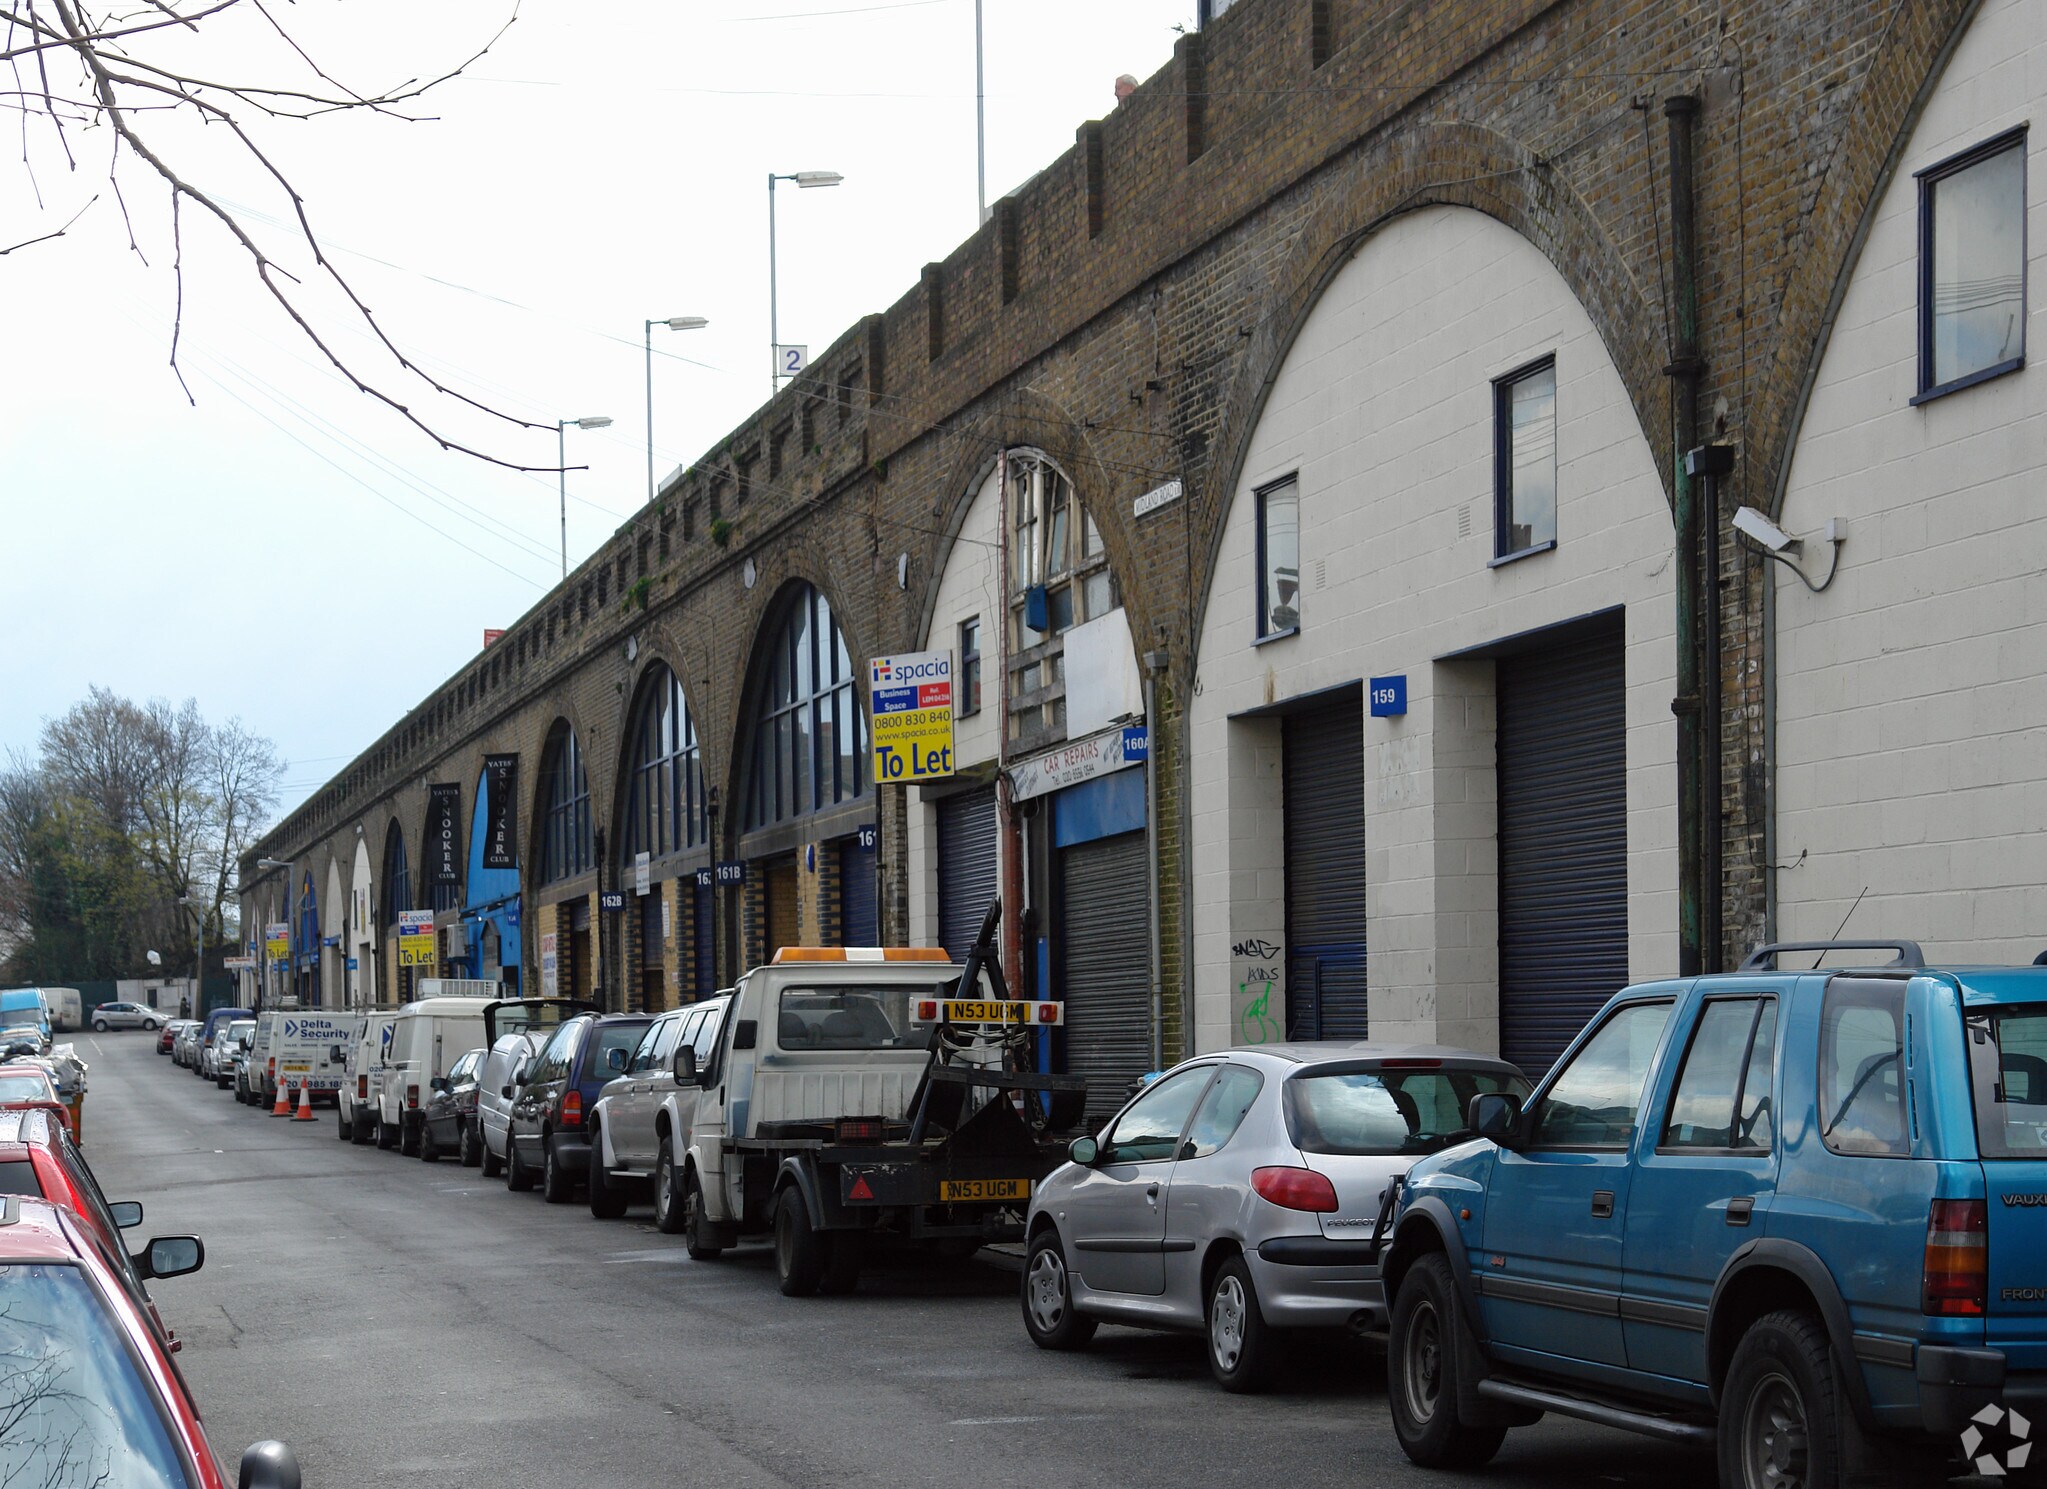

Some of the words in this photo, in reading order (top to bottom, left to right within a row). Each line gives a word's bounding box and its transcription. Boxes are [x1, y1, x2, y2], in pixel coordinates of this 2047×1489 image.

[786, 350, 801, 370] 2
[895, 658, 949, 685] spacia
[880, 689, 911, 699] Business
[1372, 689, 1395, 704] 159
[884, 702, 906, 711] Space
[874, 716, 902, 729] 0800
[905, 713, 926, 726] 830
[930, 711, 950, 723] 840
[875, 726, 950, 741] www.spacia.co.uk
[876, 746, 904, 778] To
[912, 743, 951, 775] Let
[1044, 757, 1059, 774] CAR
[1064, 741, 1098, 767] REPAIRS
[495, 768, 507, 854] SNOOKER
[442, 796, 452, 872] SNOOKER
[717, 866, 741, 879] 161B
[602, 895, 622, 907] 162B
[268, 948, 276, 958] To
[277, 948, 287, 957] Let
[401, 949, 413, 964] To
[416, 949, 433, 963] Let
[954, 1002, 984, 1018] N53
[300, 1020, 332, 1029] Delta
[300, 1029, 350, 1040] Security
[951, 1184, 982, 1199] N53
[986, 1182, 1017, 1197] UGM
[2002, 1194, 2047, 1206] VAUX
[1327, 1219, 1375, 1227] PEUGEOT
